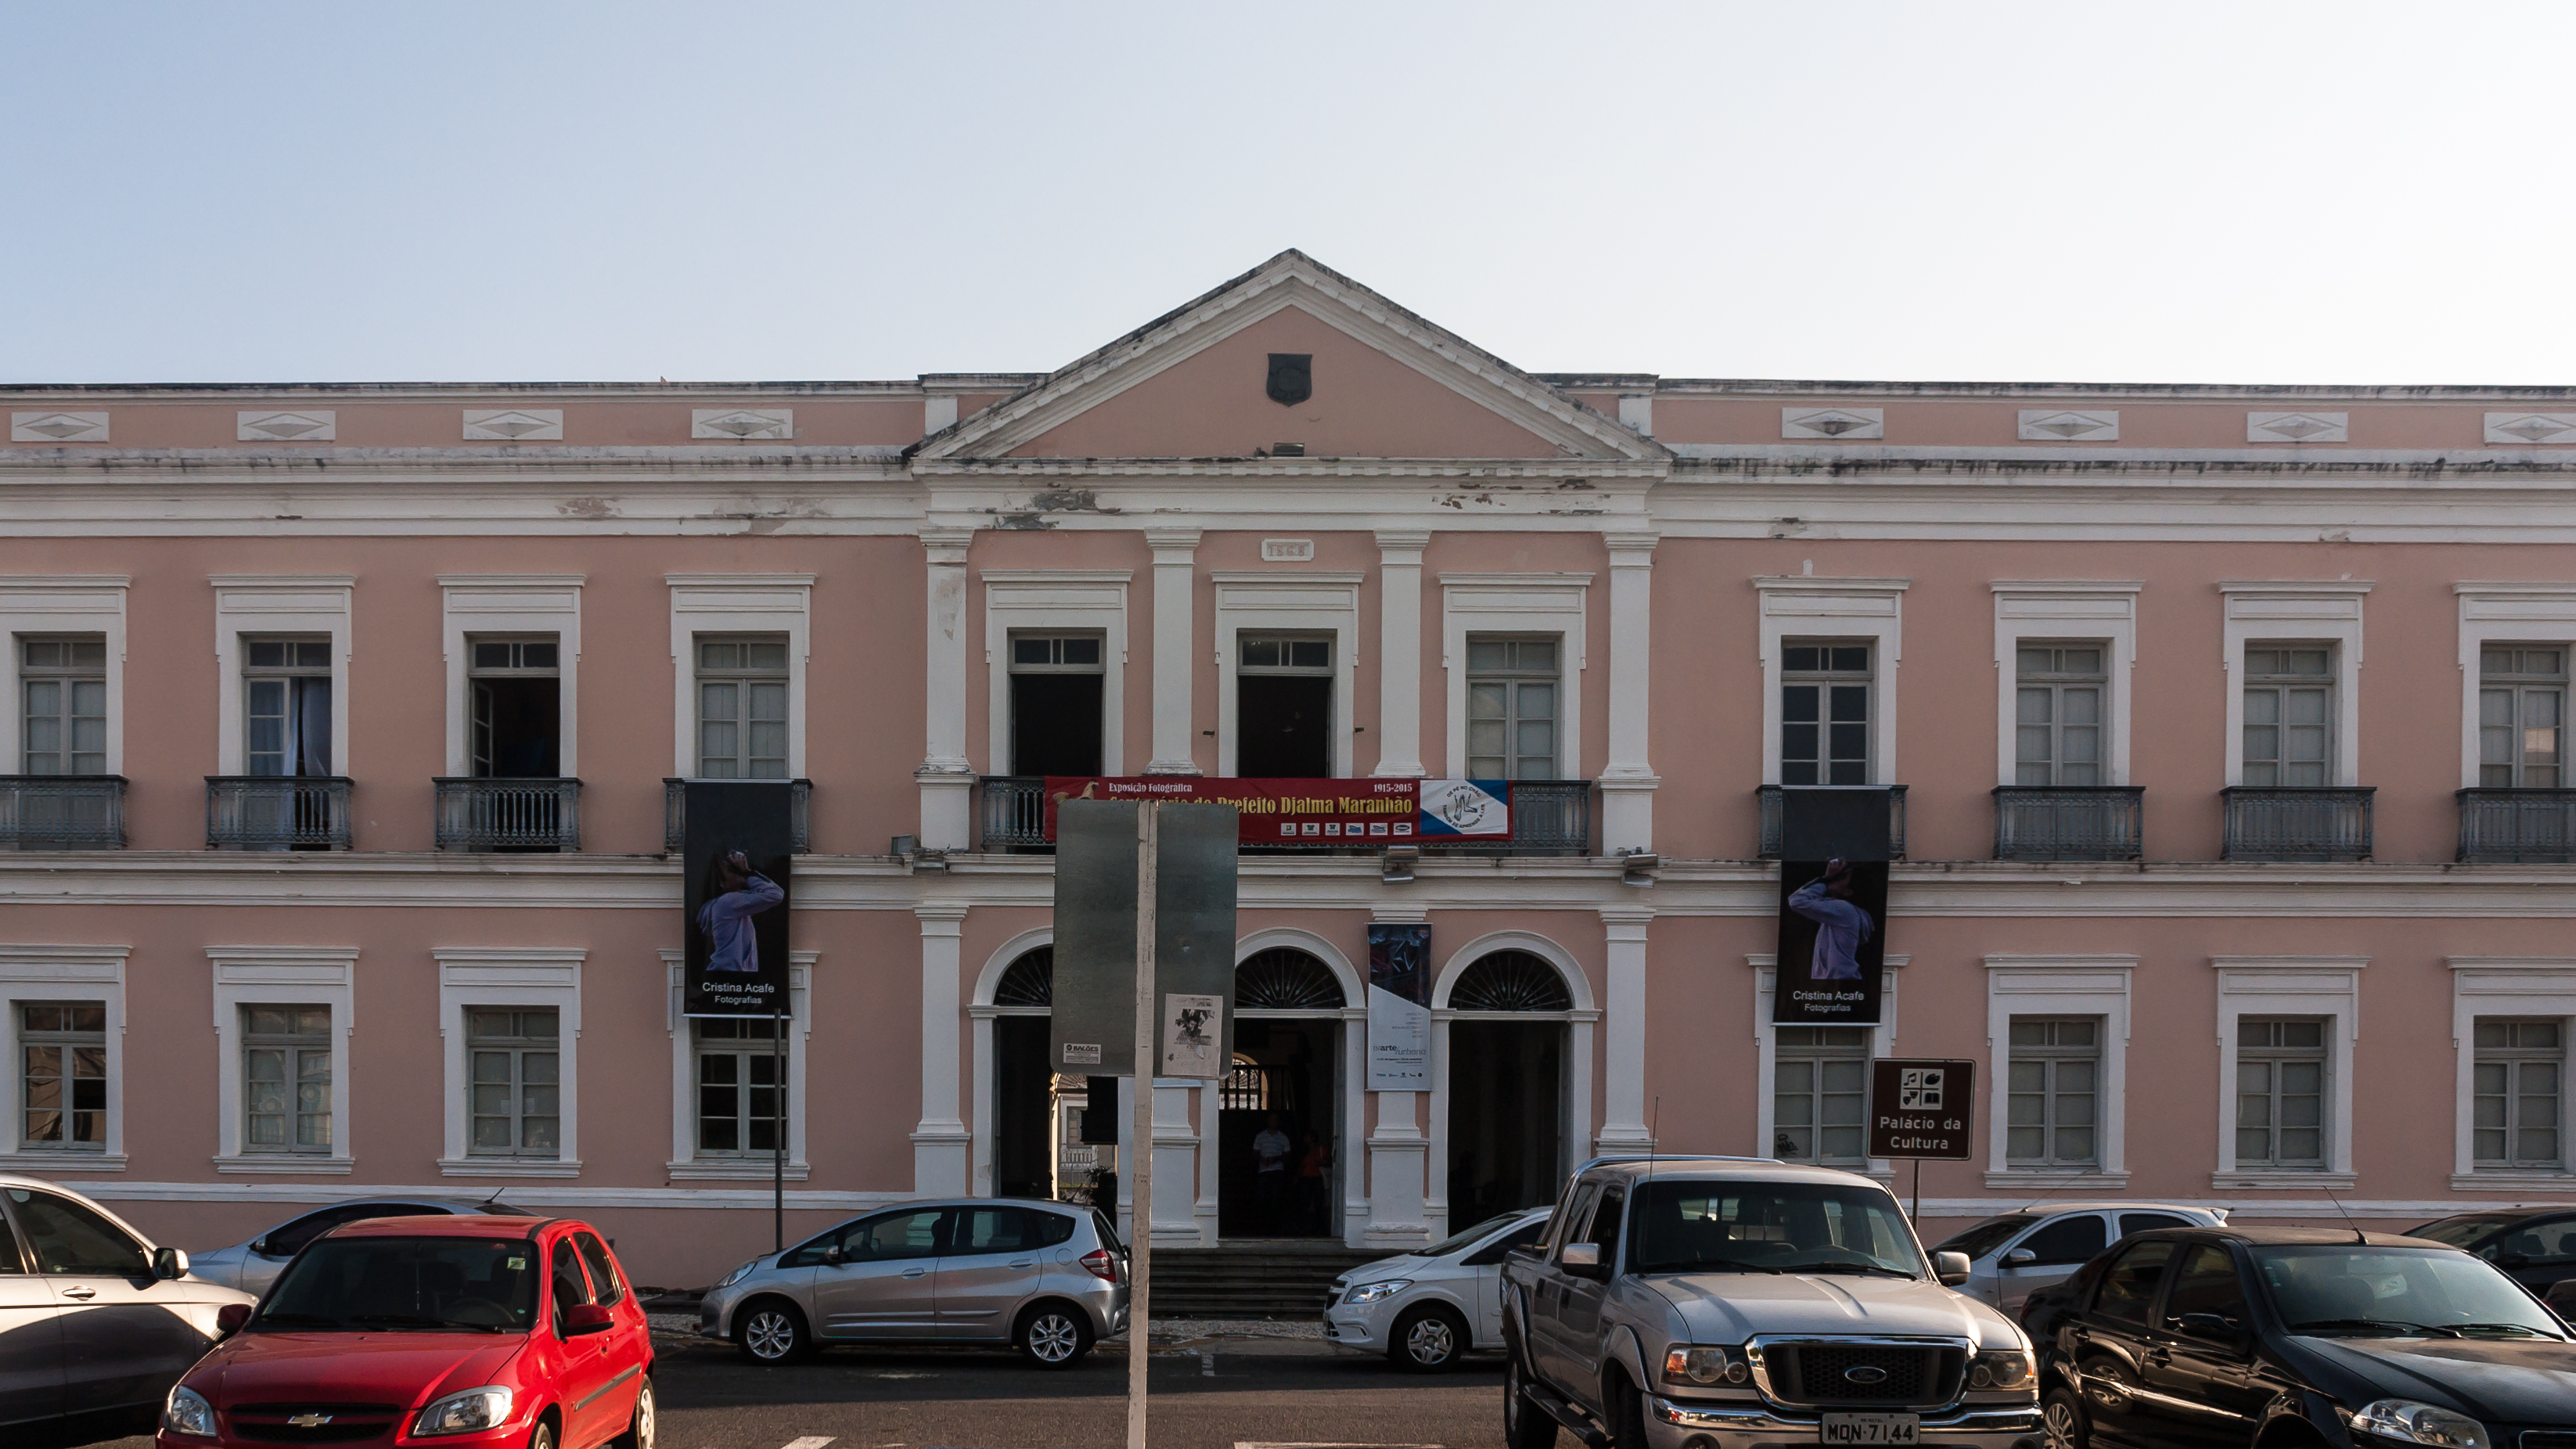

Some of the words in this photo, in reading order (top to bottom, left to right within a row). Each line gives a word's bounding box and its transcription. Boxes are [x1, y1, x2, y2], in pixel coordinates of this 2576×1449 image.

[1109, 782, 1146, 793] Exposição
[1149, 782, 1193, 793] Fotográfica
[1373, 783, 1412, 793] 1915-2015
[1281, 796, 1333, 815] Djalma
[1339, 795, 1412, 814] Maranhão
[703, 982, 742, 992] Cristina
[744, 983, 775, 993] Acafe
[714, 995, 762, 1005] Fotografias
[1793, 991, 1833, 1001] Cristina
[1834, 991, 1865, 1001] Acafe
[1804, 1003, 1851, 1013] Fotografias
[1880, 1115, 1935, 1129] Palácio
[1944, 1118, 1961, 1130] da
[1891, 1136, 1948, 1149] Cultura
